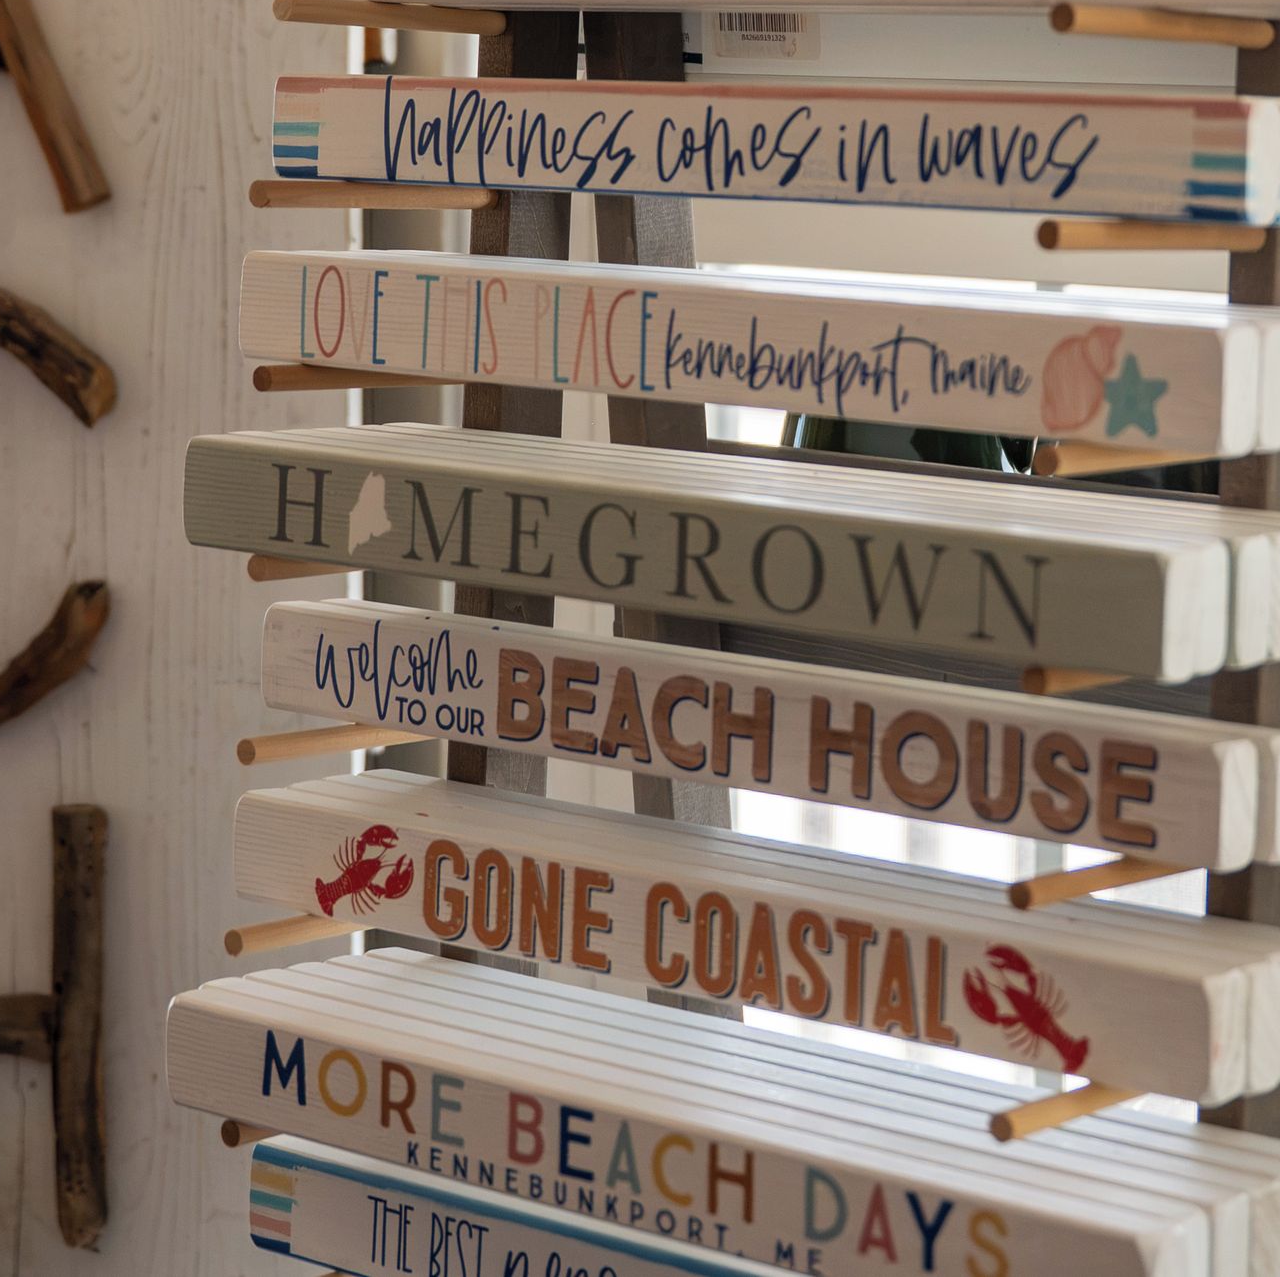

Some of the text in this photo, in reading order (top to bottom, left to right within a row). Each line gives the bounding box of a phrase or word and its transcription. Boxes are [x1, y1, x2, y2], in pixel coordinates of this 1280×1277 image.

[384, 75, 1100, 199] happiness comes in waves
[300, 264, 389, 365] LOVE
[416, 273, 507, 375] THIS
[533, 285, 658, 391] PLACE
[268, 462, 1050, 648] HMEGROWN
[395, 695, 485, 737] TO OUR
[496, 647, 1158, 850] BEACH HOUSE
[422, 838, 959, 1048] GONE COASTAL
[261, 1029, 1010, 1277] MORE BEACH DAYS
[366, 1194, 490, 1277] THE BEST
[775, 1238, 824, 1276] ME
